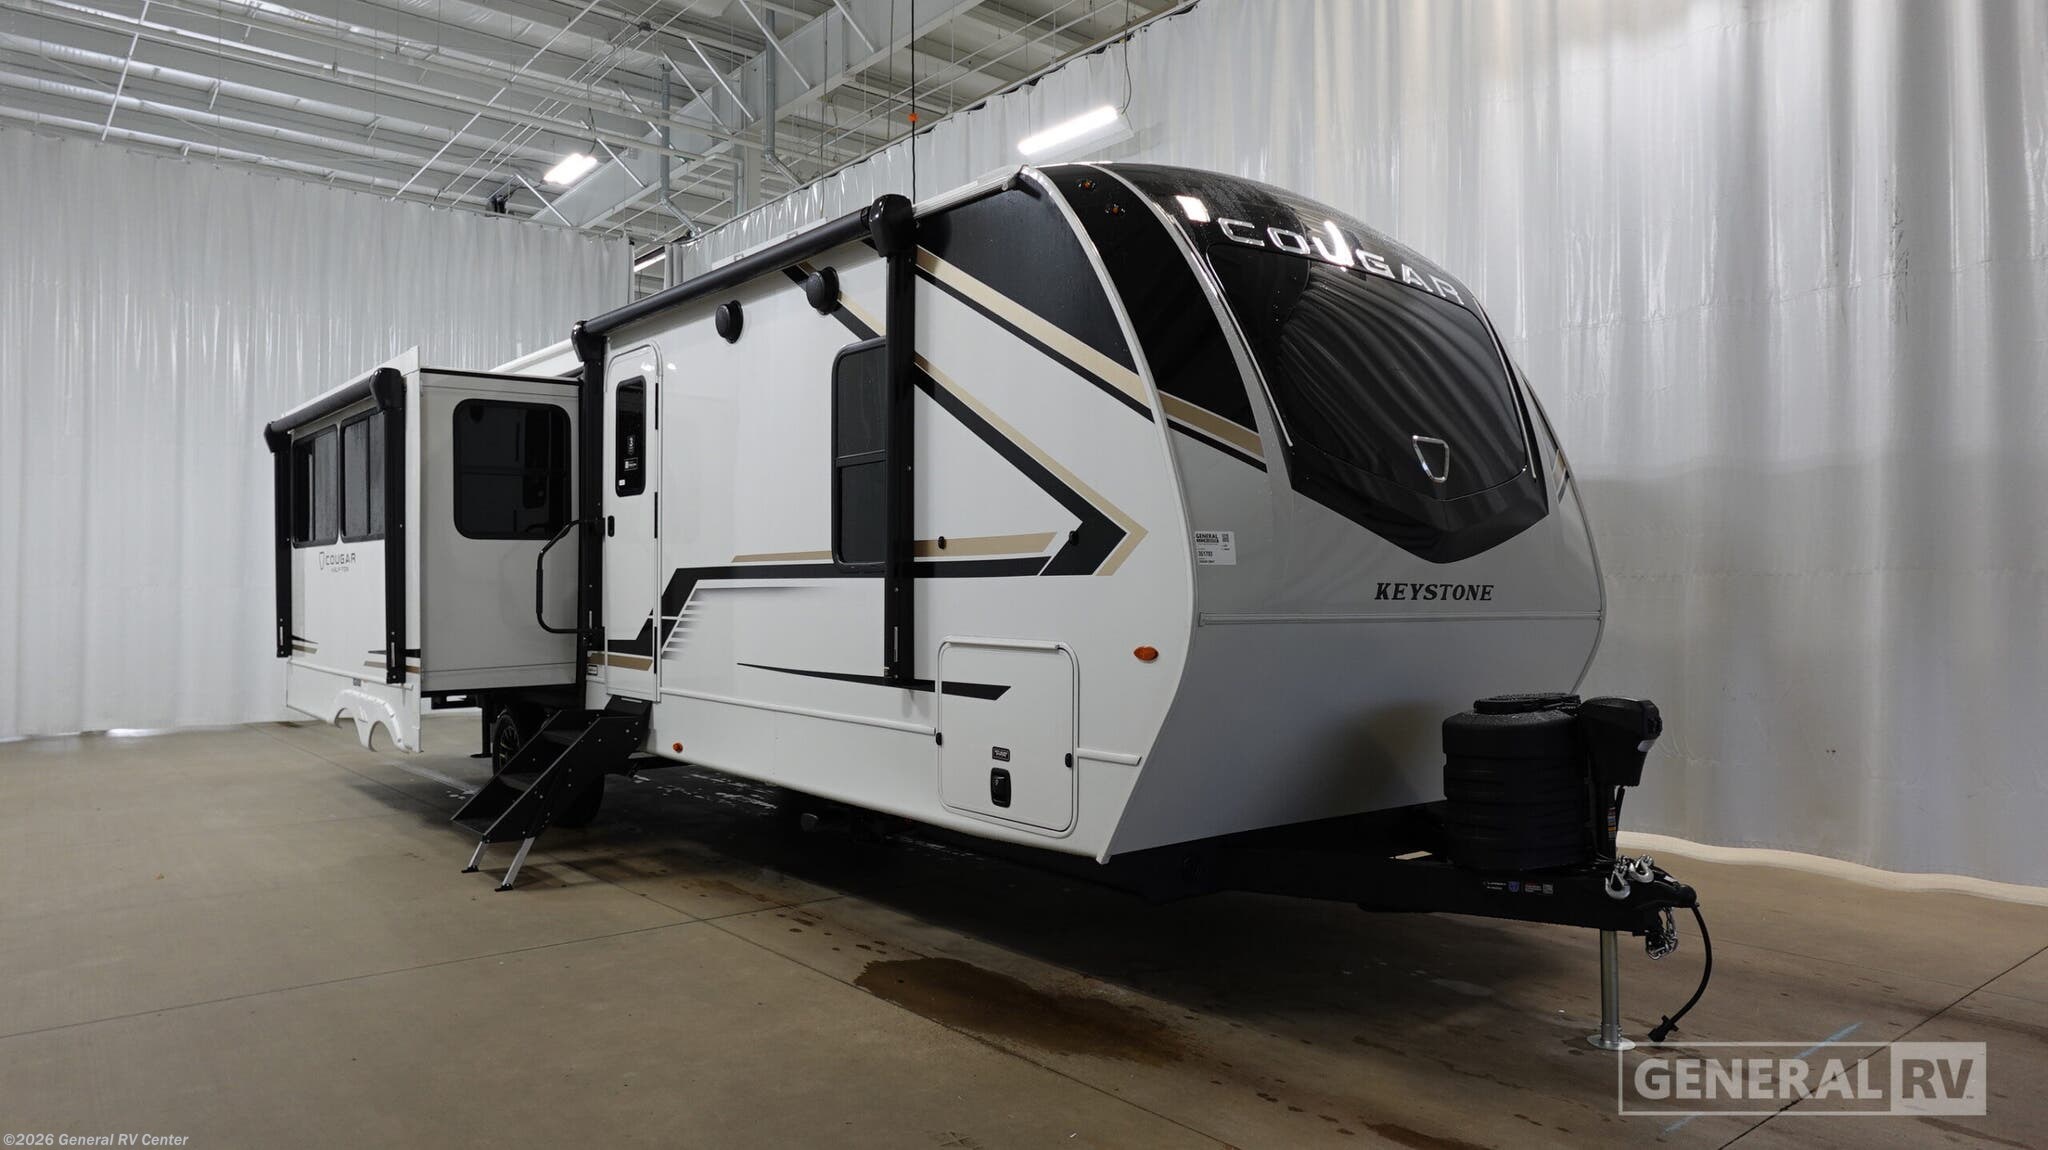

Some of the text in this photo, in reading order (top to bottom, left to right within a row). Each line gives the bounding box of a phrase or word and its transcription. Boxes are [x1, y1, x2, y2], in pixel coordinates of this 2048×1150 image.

[1218, 217, 1465, 305] COUGAR
[326, 552, 356, 565] COUGAR
[1374, 582, 1495, 601] KEYSTONE
